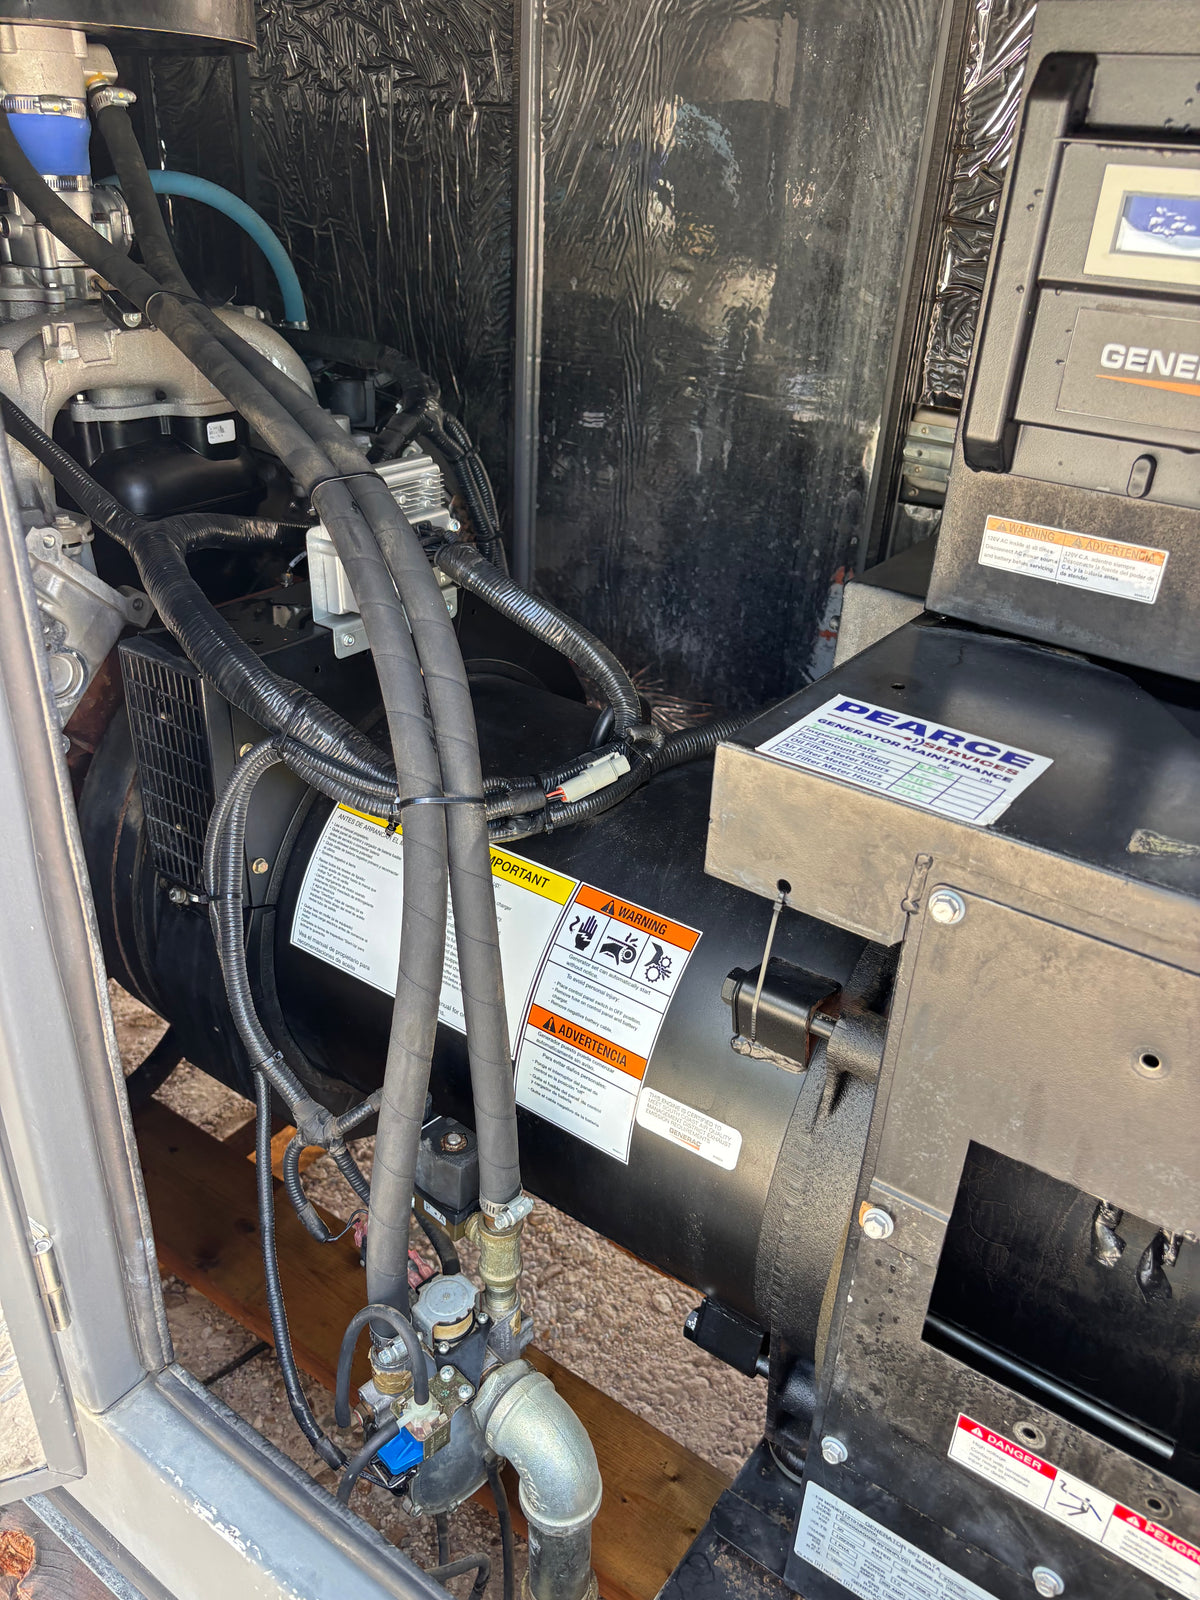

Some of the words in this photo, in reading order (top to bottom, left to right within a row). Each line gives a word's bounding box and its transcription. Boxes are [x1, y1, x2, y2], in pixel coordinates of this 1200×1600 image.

[1100, 343, 1200, 381] GENE
[1008, 523, 1055, 541] WARNING
[1029, 562, 1054, 573] servicing.
[1084, 540, 1155, 563] ADVERTENCIA
[796, 732, 820, 741] Fuel
[817, 739, 858, 754] Amount
[856, 751, 891, 765] Added
[803, 727, 854, 745] Inspection
[852, 743, 878, 753] Date
[815, 717, 902, 747] GENERATOR
[901, 744, 1014, 783] MAINTENANCE
[833, 700, 1035, 769] PEARCE
[773, 747, 796, 756] Fuel
[794, 754, 824, 766] Filter
[821, 763, 852, 775] Meter
[850, 772, 883, 786] Hours
[780, 742, 800, 750] Air
[798, 747, 828, 759] Filter
[825, 756, 855, 768] Meter
[854, 766, 884, 778] Hours
[788, 737, 808, 745] Oil
[805, 742, 835, 754] Filter
[833, 751, 862, 763] Meter
[861, 760, 891, 773] Hours
[921, 741, 1020, 775] SERVICES
[337, 812, 355, 825] ANTES
[354, 819, 363, 828] DE
[490, 856, 550, 888] MPORTANT
[618, 906, 668, 936] WARNING
[311, 936, 328, 950] manual
[565, 960, 582, 971] without
[568, 953, 591, 967] Generator
[607, 972, 639, 990] automatically
[639, 986, 651, 995] start
[556, 981, 568, 990] Place
[567, 986, 582, 997] control
[582, 993, 594, 1003] panel
[594, 999, 608, 1010] switch
[612, 1008, 622, 1016] OFF
[572, 976, 585, 986] avoid
[585, 982, 605, 996] personal
[550, 999, 566, 1011] Remove
[566, 1007, 584, 1019] negative
[584, 1016, 599, 1027] battery
[554, 987, 571, 999] Remove
[613, 1015, 622, 1023] and
[621, 1019, 638, 1031] battery
[542, 1052, 552, 1062] Para
[558, 1022, 628, 1067] ADVERTENCIA
[645, 1108, 669, 1123] EMISSION
[670, 1120, 711, 1144] REQUIREMENTS
[646, 1103, 682, 1124] MANAGEMENT
[682, 1120, 705, 1135] DISTRICT
[706, 1132, 730, 1148] EXHAUST
[647, 1097, 661, 1107] MEET
[661, 1104, 680, 1116] SOUTH
[680, 1113, 697, 1125] COAST
[698, 1122, 708, 1130] AIR
[708, 1127, 731, 1142] QUALITY
[648, 1092, 660, 1101] THIS
[661, 1098, 680, 1111] ENGINE
[686, 1110, 713, 1127] CERTIFIED
[714, 1123, 721, 1131] TO
[668, 1127, 701, 1147] GENERAC
[986, 1432, 1041, 1471] DANGER
[864, 1521, 906, 1551] GENERATOR
[921, 1556, 940, 1572] DATA
